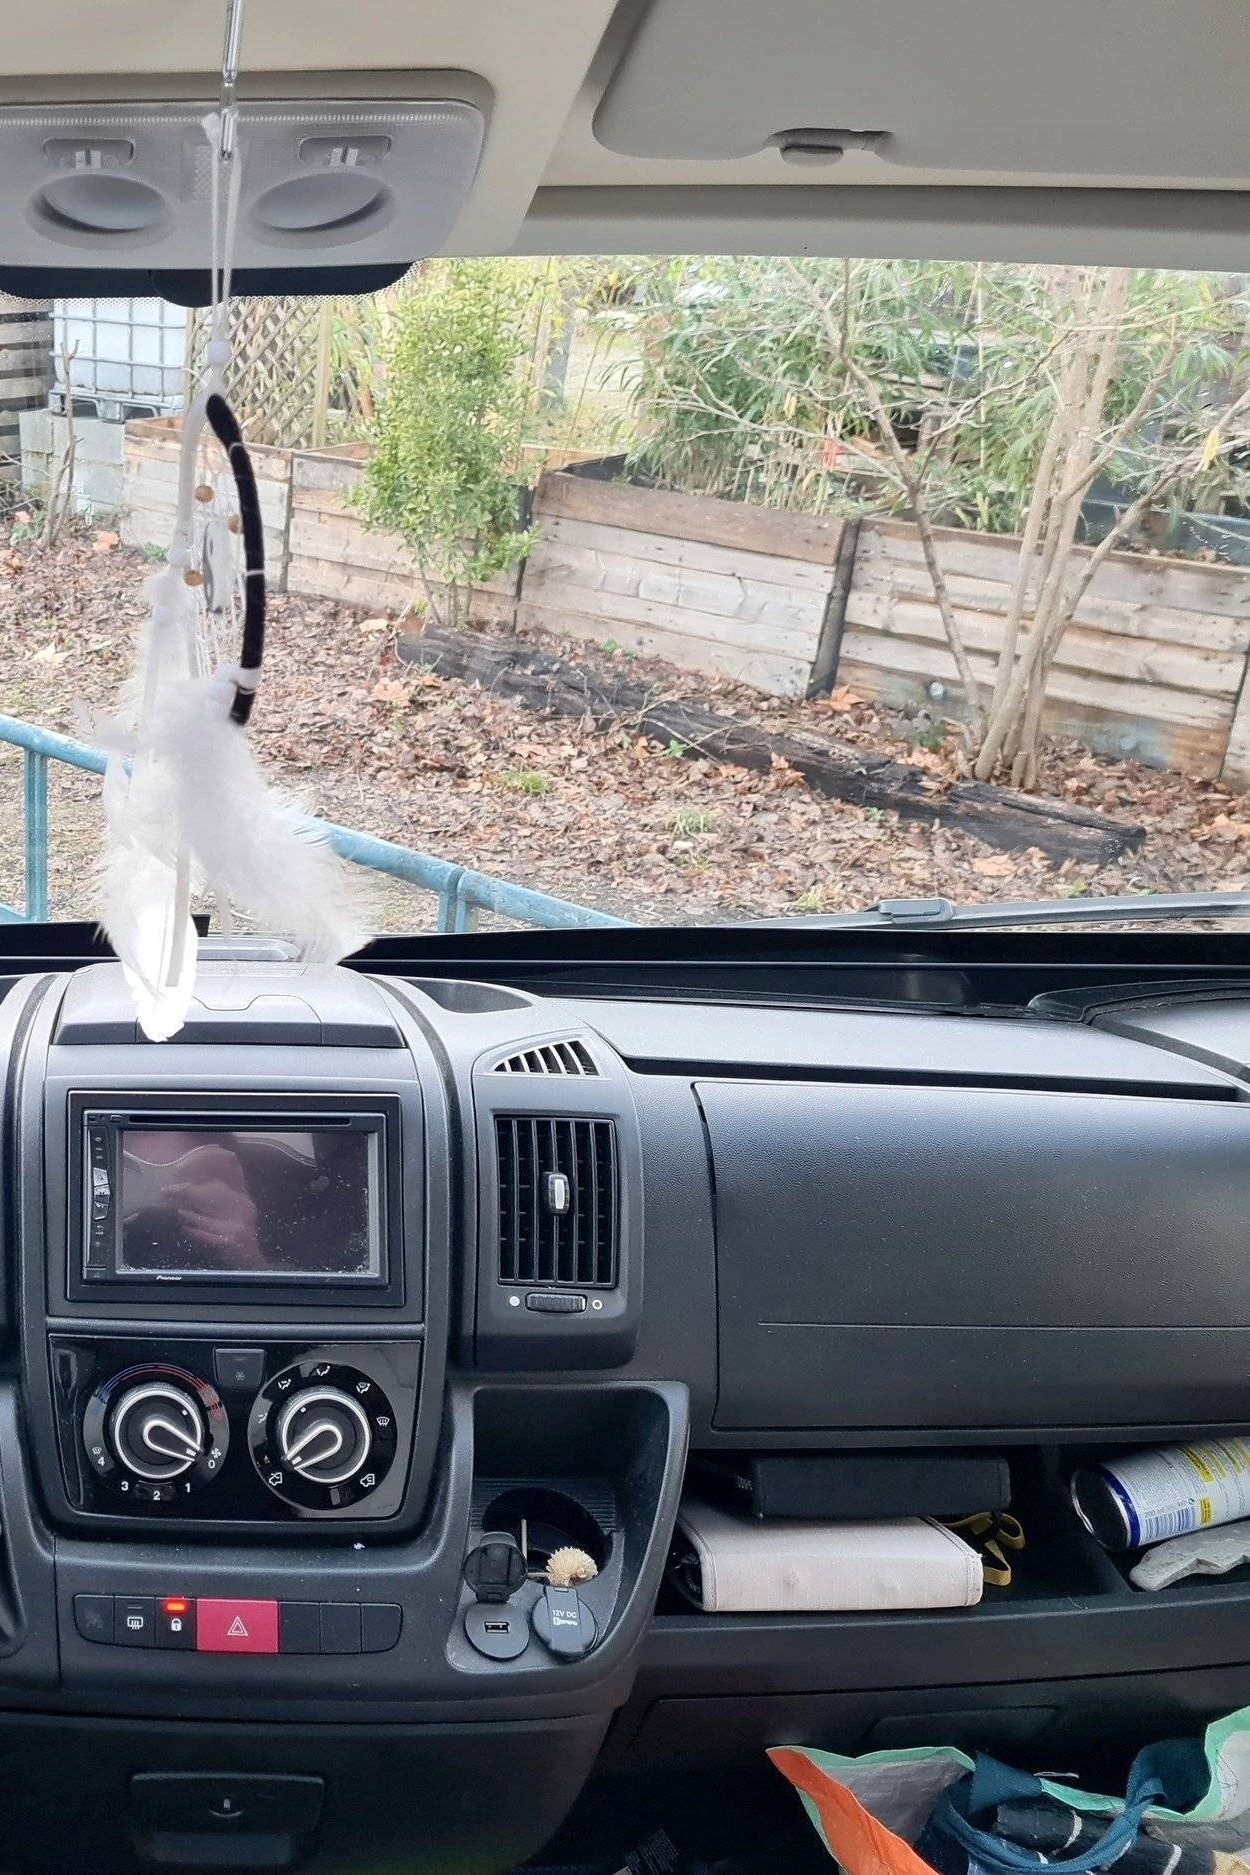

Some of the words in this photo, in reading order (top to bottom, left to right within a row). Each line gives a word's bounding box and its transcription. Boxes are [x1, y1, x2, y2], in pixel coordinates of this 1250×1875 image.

[97, 1456, 106, 1466] 4
[208, 1459, 216, 1469] 0
[121, 1481, 129, 1491] 3
[184, 1482, 191, 1493] 1
[152, 1490, 161, 1501] 2
[552, 1609, 565, 1617] 12V
